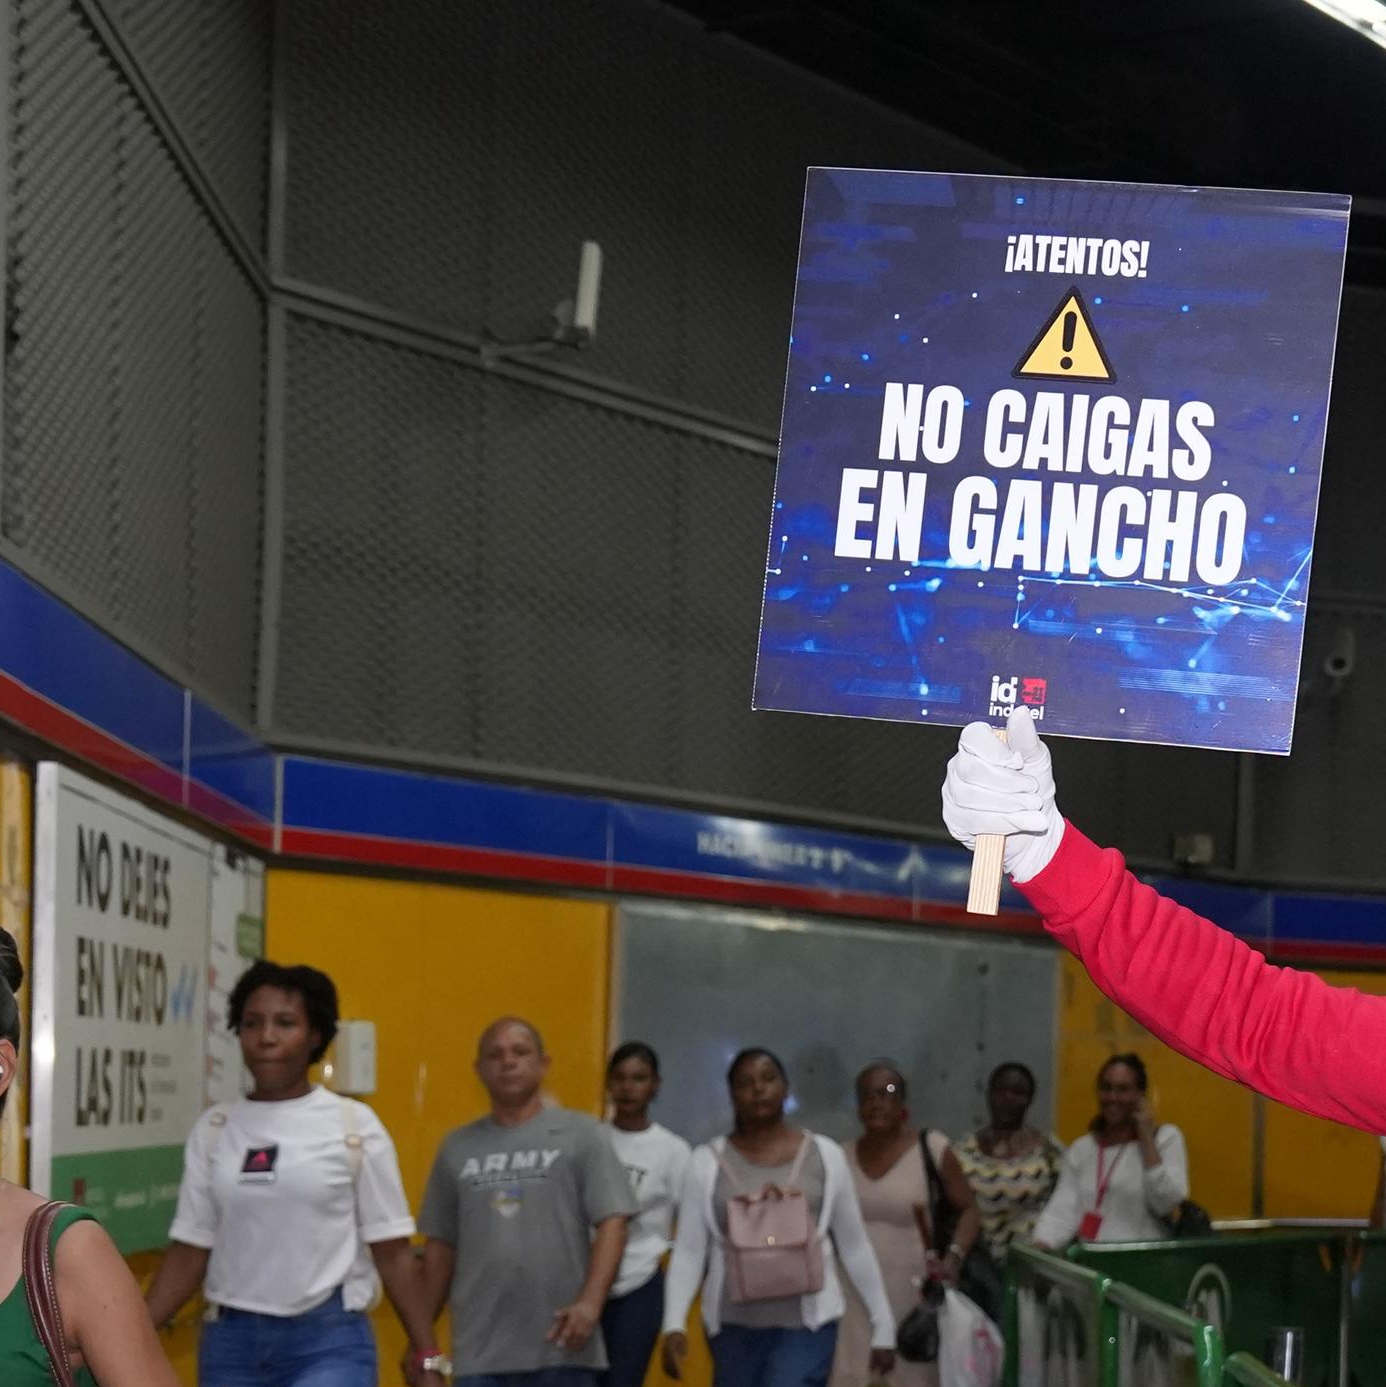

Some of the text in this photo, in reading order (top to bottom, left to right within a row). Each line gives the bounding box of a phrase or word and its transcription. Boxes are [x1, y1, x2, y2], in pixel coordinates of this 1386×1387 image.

[1004, 234, 1150, 278] ¡ATENTOS!
[878, 382, 1215, 481] NO CAIGAS
[834, 468, 1247, 586] EN GANCHO
[989, 702, 1044, 720] indel
[76, 824, 172, 931] NO DEJES
[76, 935, 168, 1026] EN VISTO
[75, 1047, 112, 1128] LAS
[119, 1049, 147, 1125] ITS
[459, 1148, 562, 1180] ARMY
